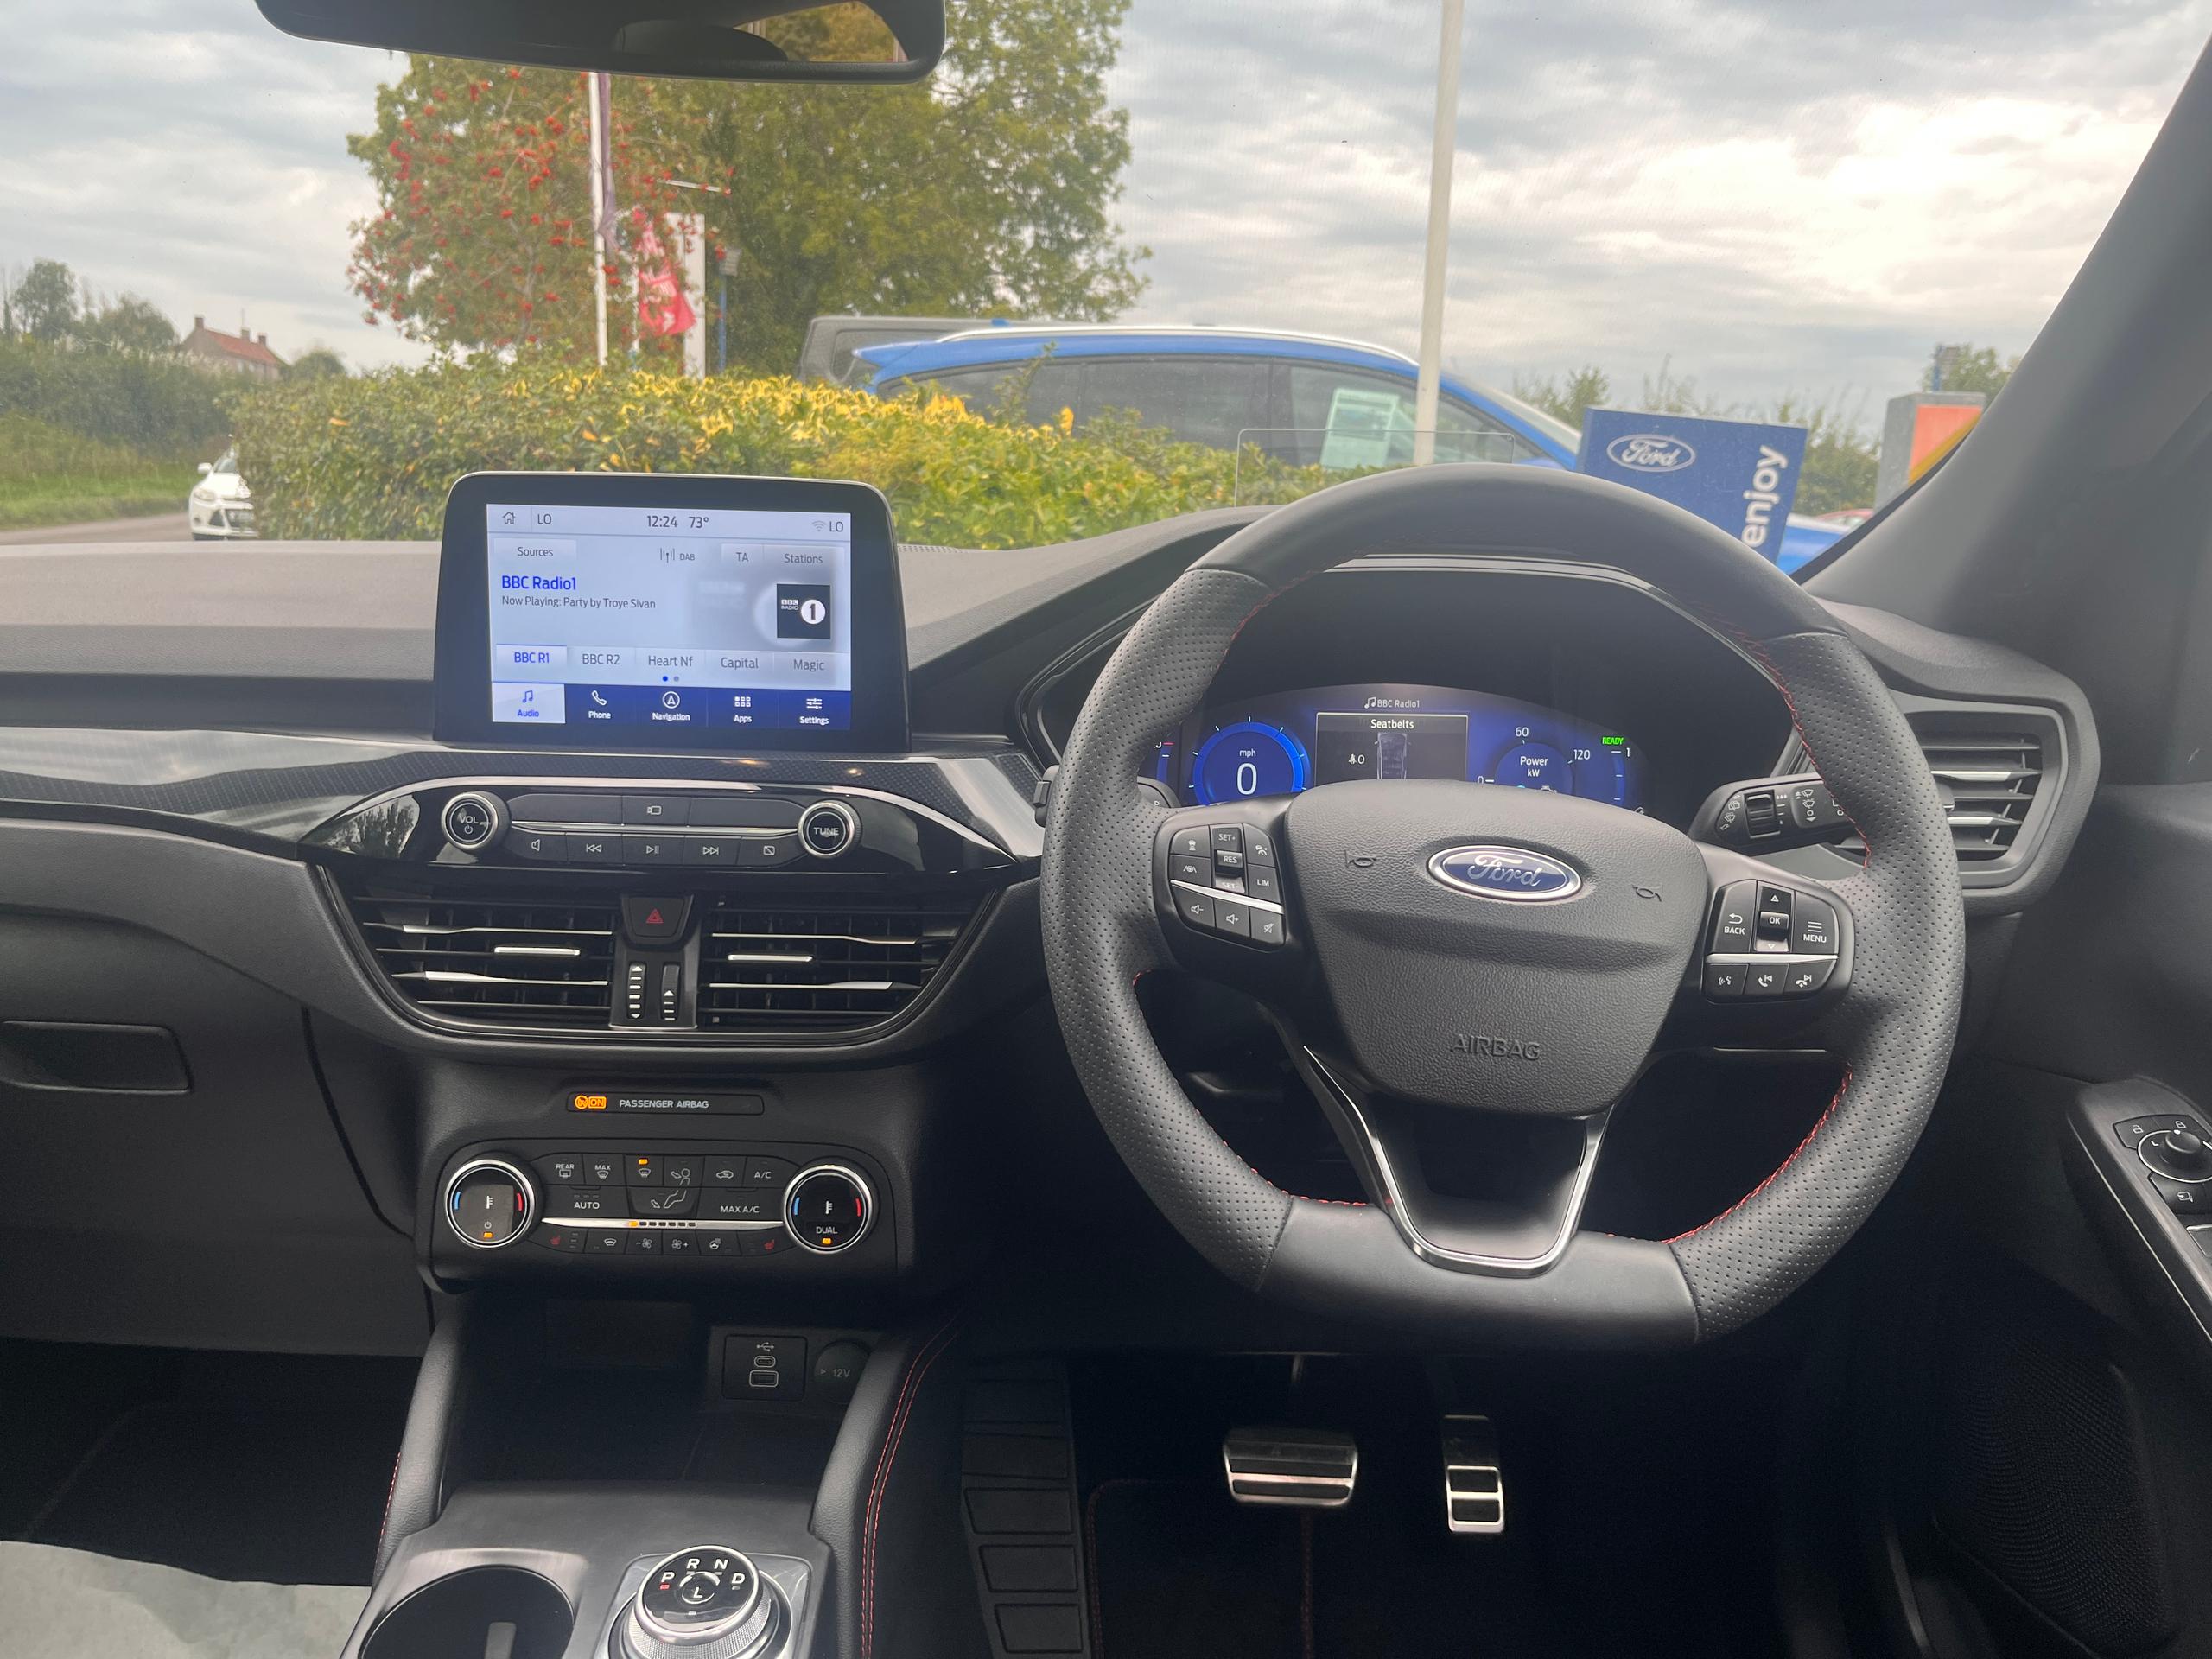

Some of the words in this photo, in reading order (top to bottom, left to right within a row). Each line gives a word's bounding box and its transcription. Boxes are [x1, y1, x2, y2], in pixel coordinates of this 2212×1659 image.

[1621, 439, 1681, 467] Ford
[1741, 445, 1789, 548] enjoy
[537, 513, 552, 524] LO
[647, 516, 677, 528] 12:24
[830, 521, 844, 532] LO
[518, 547, 554, 557] Sources
[736, 552, 749, 563] TA
[784, 553, 823, 564] Stations
[501, 575, 529, 589] BBC
[532, 576, 576, 590] Radio1
[502, 595, 523, 606] Now
[524, 596, 562, 608] Playing:
[563, 597, 588, 609] Party
[589, 597, 601, 609] by
[603, 598, 629, 610] Troye
[630, 599, 656, 608] Sivan
[810, 603, 816, 620] 1
[514, 652, 536, 663] BBC
[538, 652, 550, 664] R1
[582, 654, 604, 664] BBC
[606, 654, 620, 665] R2
[648, 655, 677, 666] Heart
[680, 656, 693, 667] Nf
[721, 657, 759, 670] Capital
[793, 659, 824, 672] Magic
[1395, 700, 1420, 709] Radio1
[517, 709, 540, 718] Audio
[588, 711, 612, 720] Phone
[652, 712, 690, 722] Navigation
[734, 715, 753, 724] Apps
[799, 716, 830, 726] Settings
[1370, 719, 1414, 729] Seatbelts
[1515, 727, 1529, 737] 60
[1239, 748, 1256, 758] mph
[1573, 749, 1591, 760] 120
[1626, 747, 1630, 757] 1
[1520, 756, 1548, 766] Power
[1528, 768, 1540, 777] kW
[1236, 762, 1257, 796] 0
[813, 826, 839, 836] TUNE
[1467, 855, 1543, 887] Ford
[1724, 926, 1745, 935] BACK
[1803, 934, 1827, 943] MENU
[1452, 1034, 1541, 1061] AIRBAG
[620, 1100, 673, 1109] PASSENGER
[677, 1100, 709, 1109] AIRBAG
[816, 1226, 837, 1235] DUAL
[833, 1368, 851, 1377] 12V
[687, 1558, 701, 1569] R
[714, 1559, 729, 1569] N
[661, 1572, 675, 1582] P
[731, 1573, 746, 1584] D
[692, 1586, 703, 1598] L
